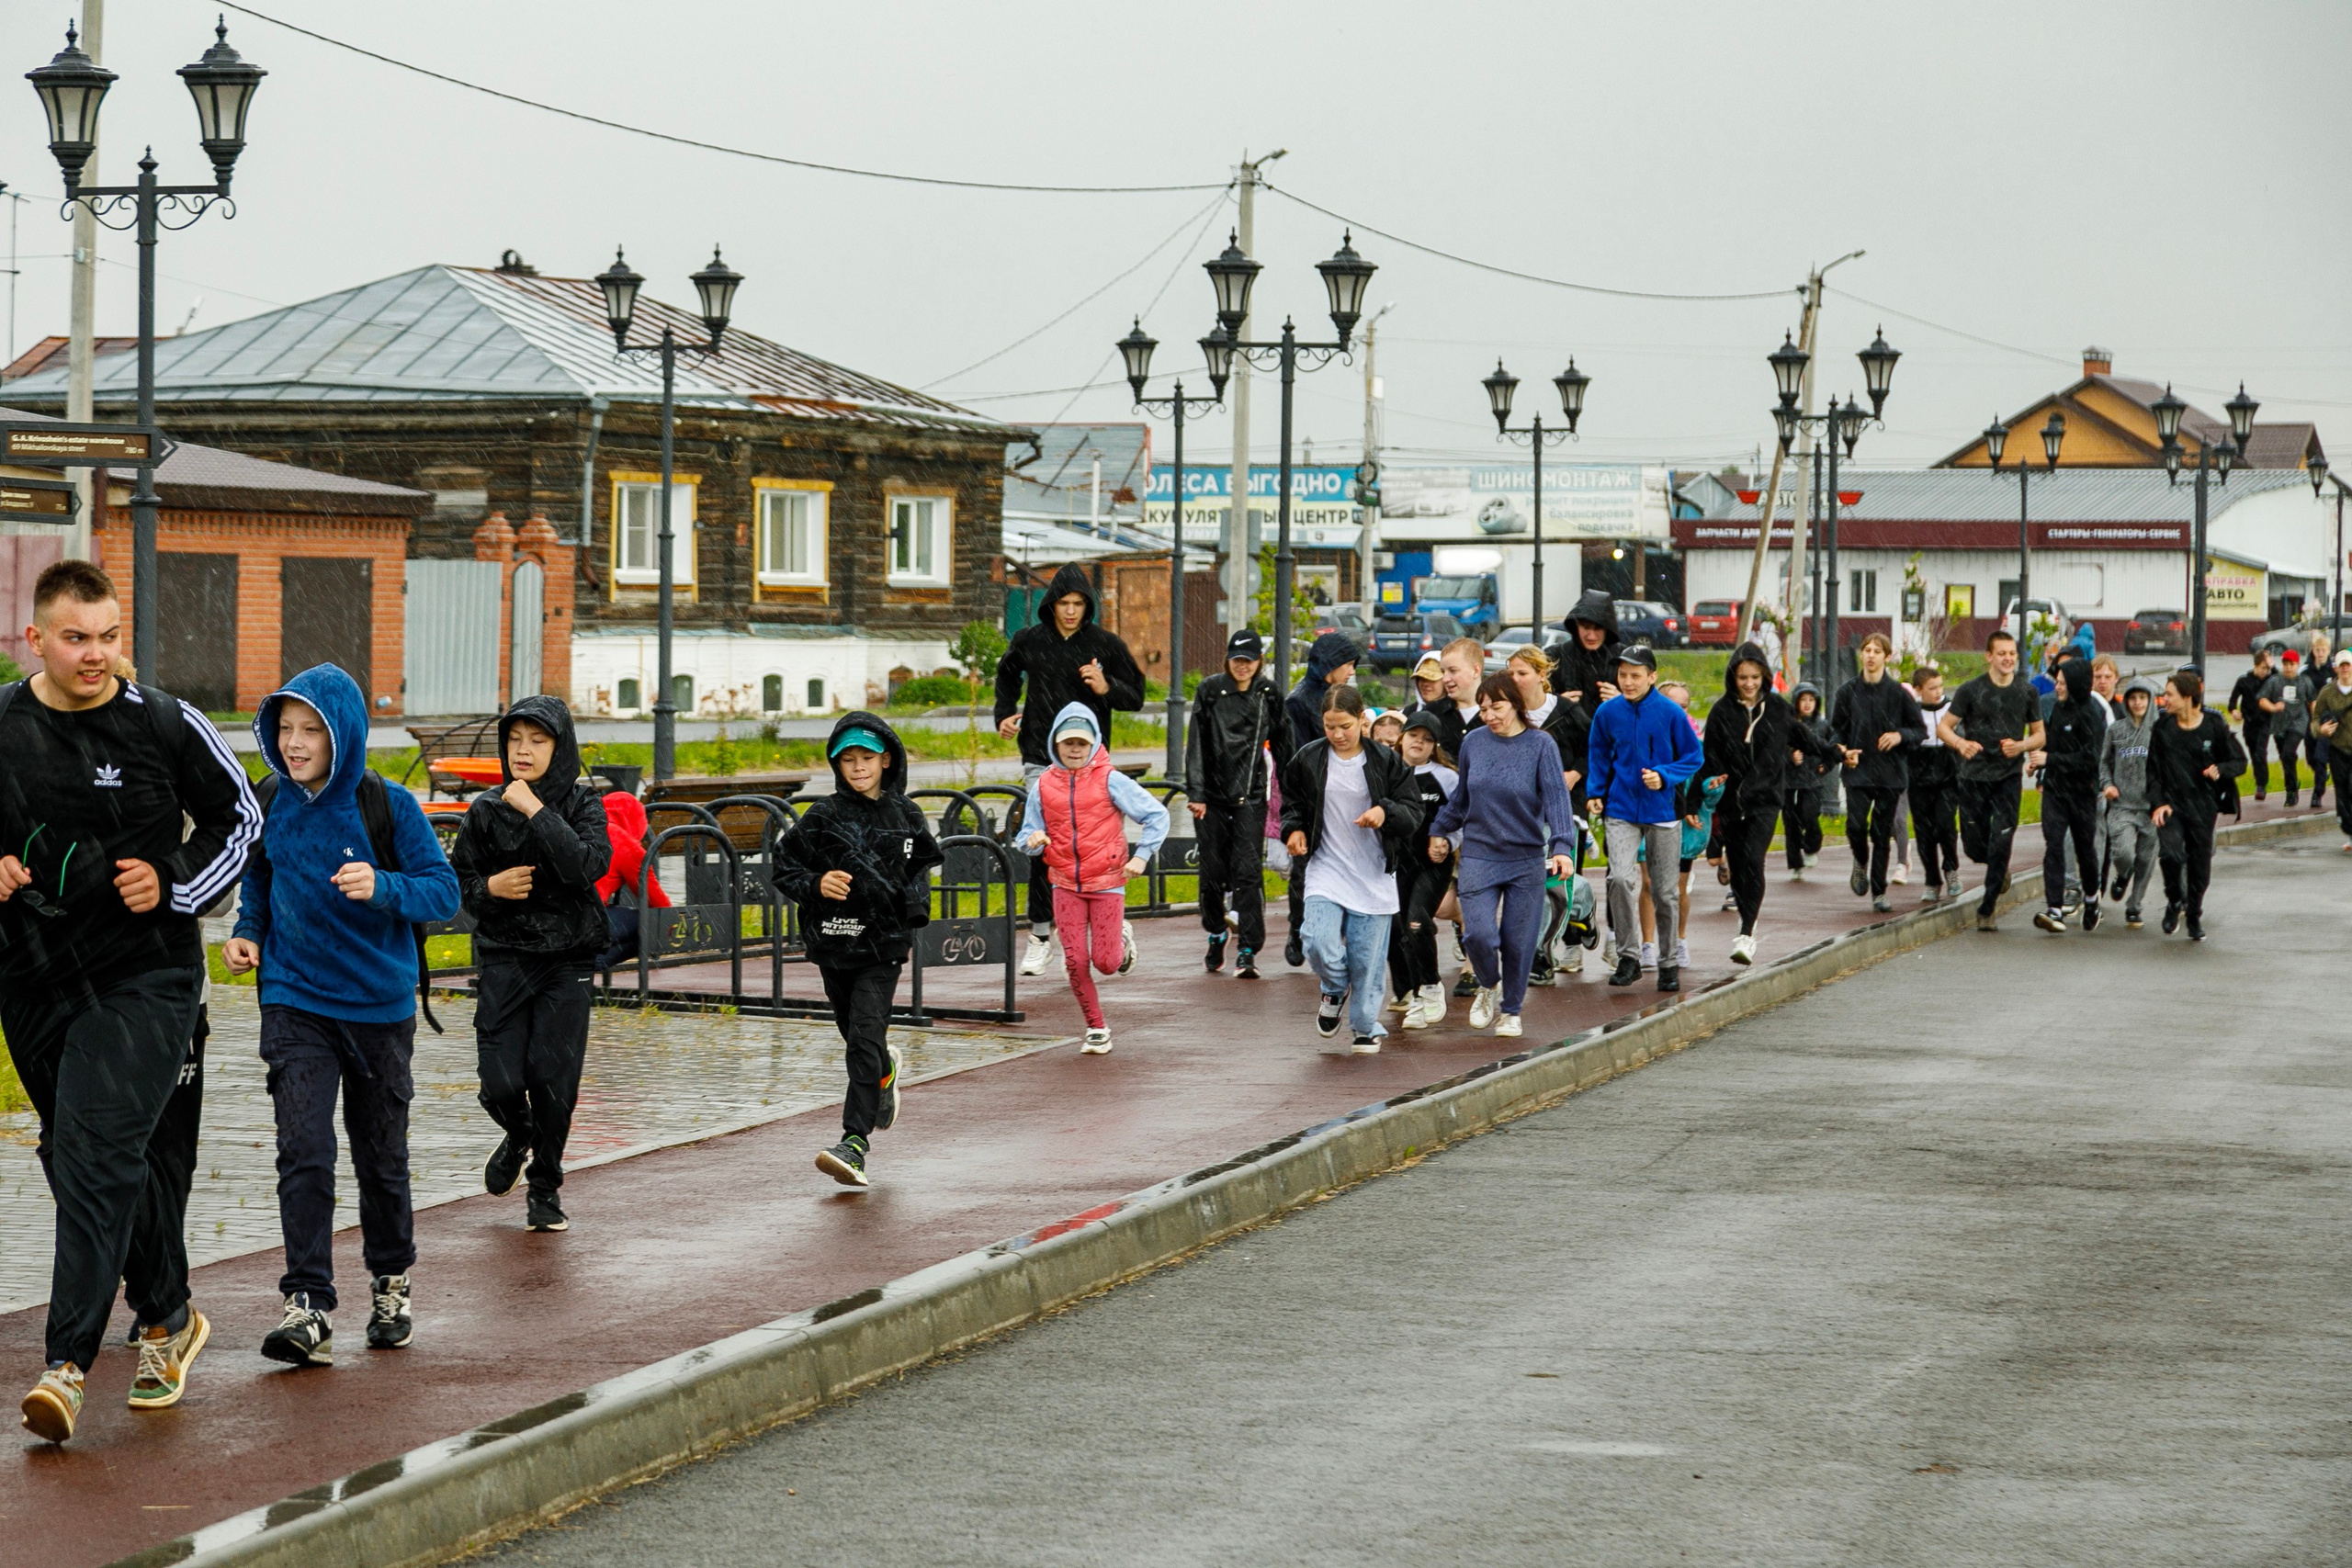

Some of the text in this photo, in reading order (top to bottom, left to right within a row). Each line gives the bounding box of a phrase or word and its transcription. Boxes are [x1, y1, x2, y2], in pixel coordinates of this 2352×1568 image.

[1294, 509, 1348, 525] ЦЕНТР
[2204, 576, 2256, 586] АПРАВКА
[2206, 588, 2245, 600] АВТО
[821, 920, 865, 931] WITHOUT
